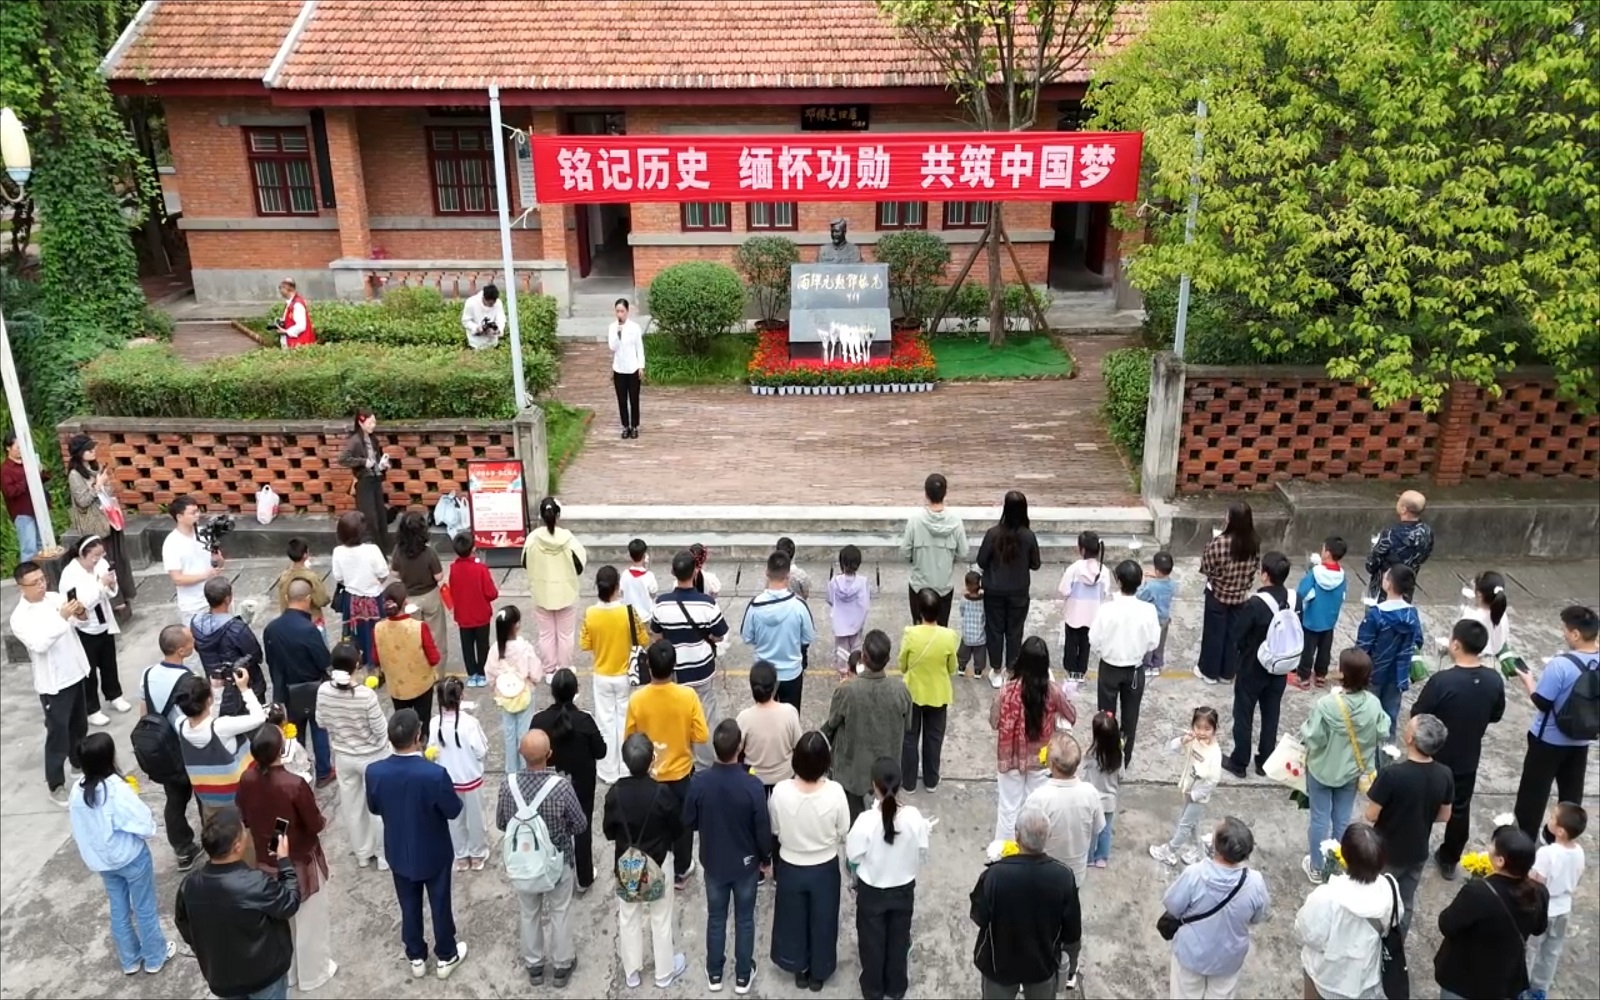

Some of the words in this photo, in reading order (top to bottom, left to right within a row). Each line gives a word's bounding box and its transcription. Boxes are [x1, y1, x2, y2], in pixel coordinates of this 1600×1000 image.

[557, 146, 710, 191] 铭记历史
[738, 144, 890, 190] 缅怀功勋
[920, 143, 1115, 189] 共筑中国梦
